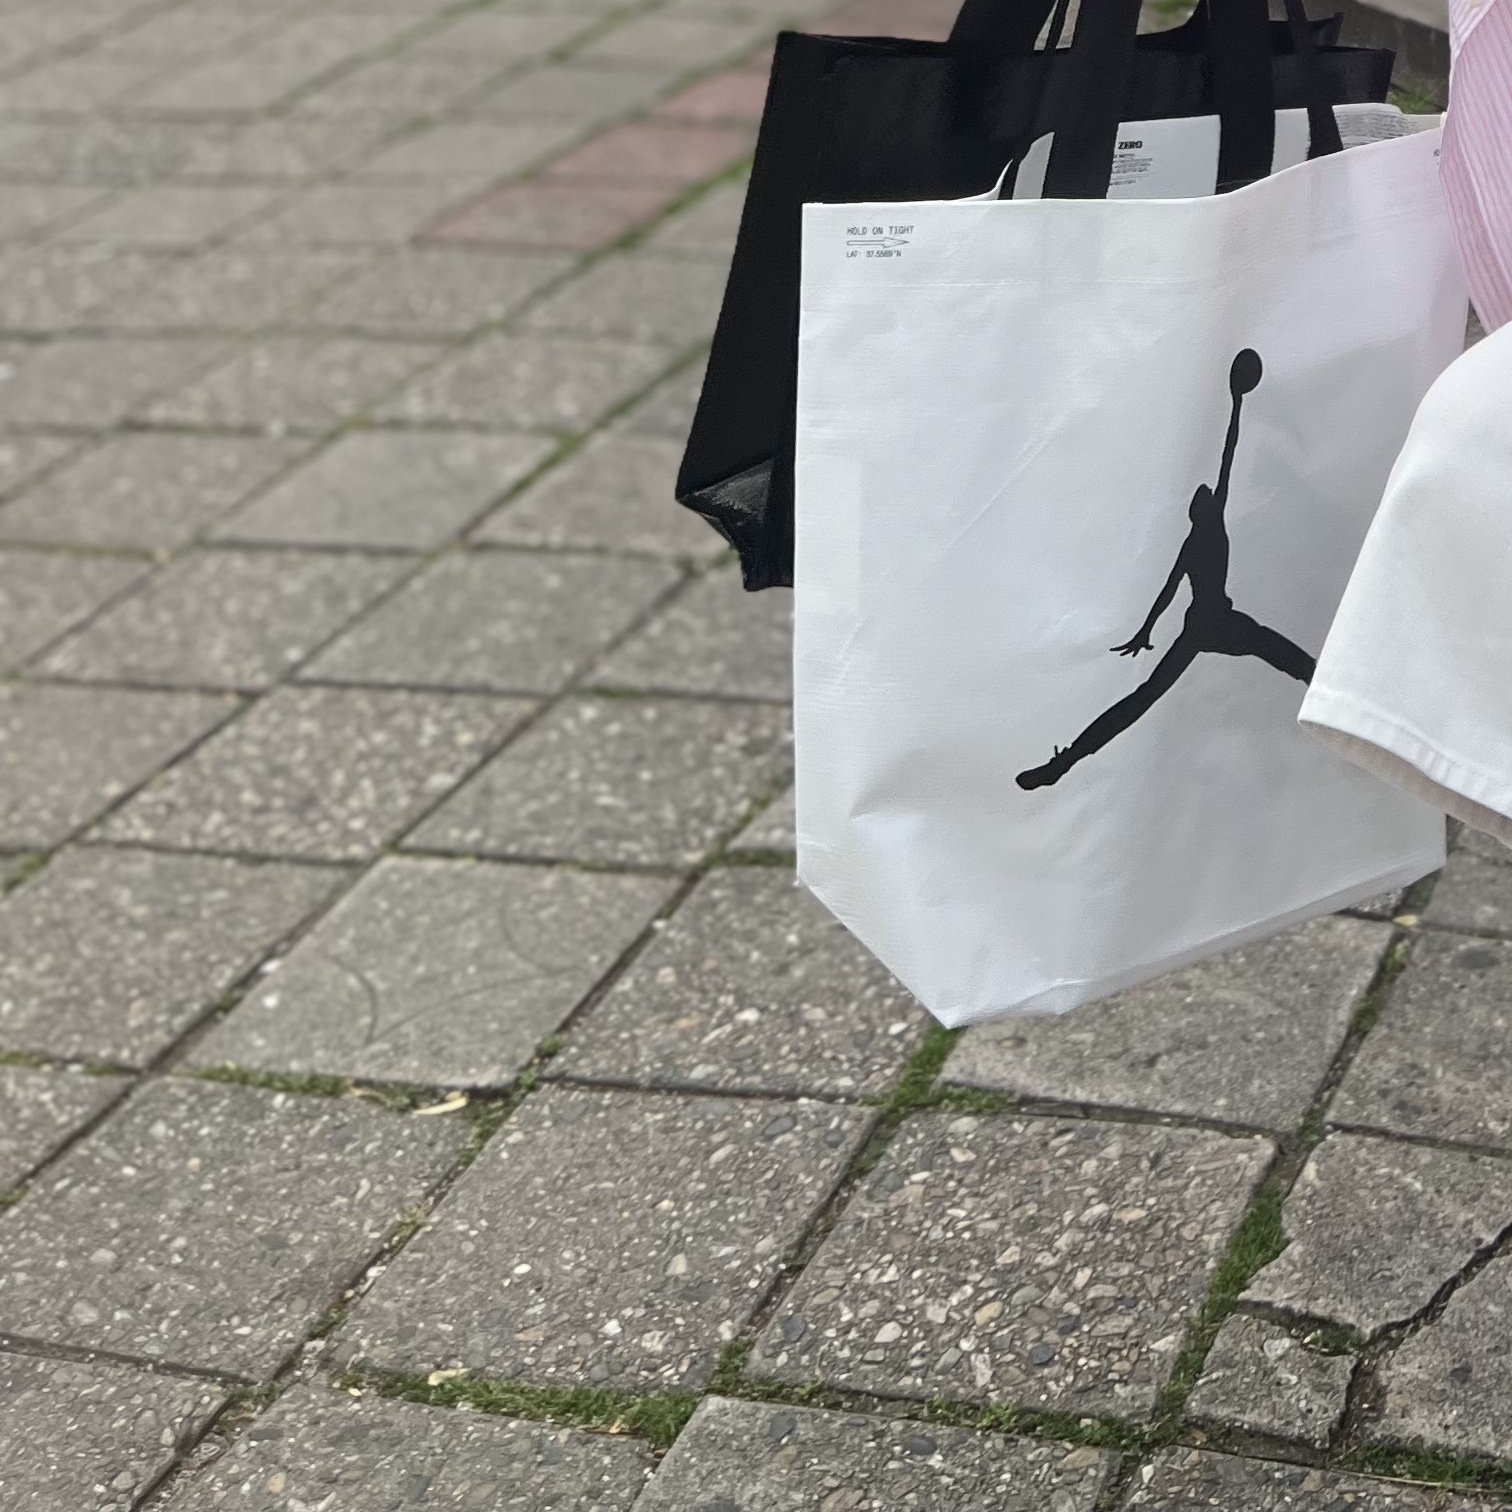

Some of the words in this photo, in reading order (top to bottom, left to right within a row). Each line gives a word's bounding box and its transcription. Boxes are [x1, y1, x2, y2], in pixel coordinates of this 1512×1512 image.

[1118, 140, 1143, 149] ZERO
[847, 226, 868, 235] HOLD
[872, 226, 884, 235] ON
[888, 225, 915, 235] TIGHT
